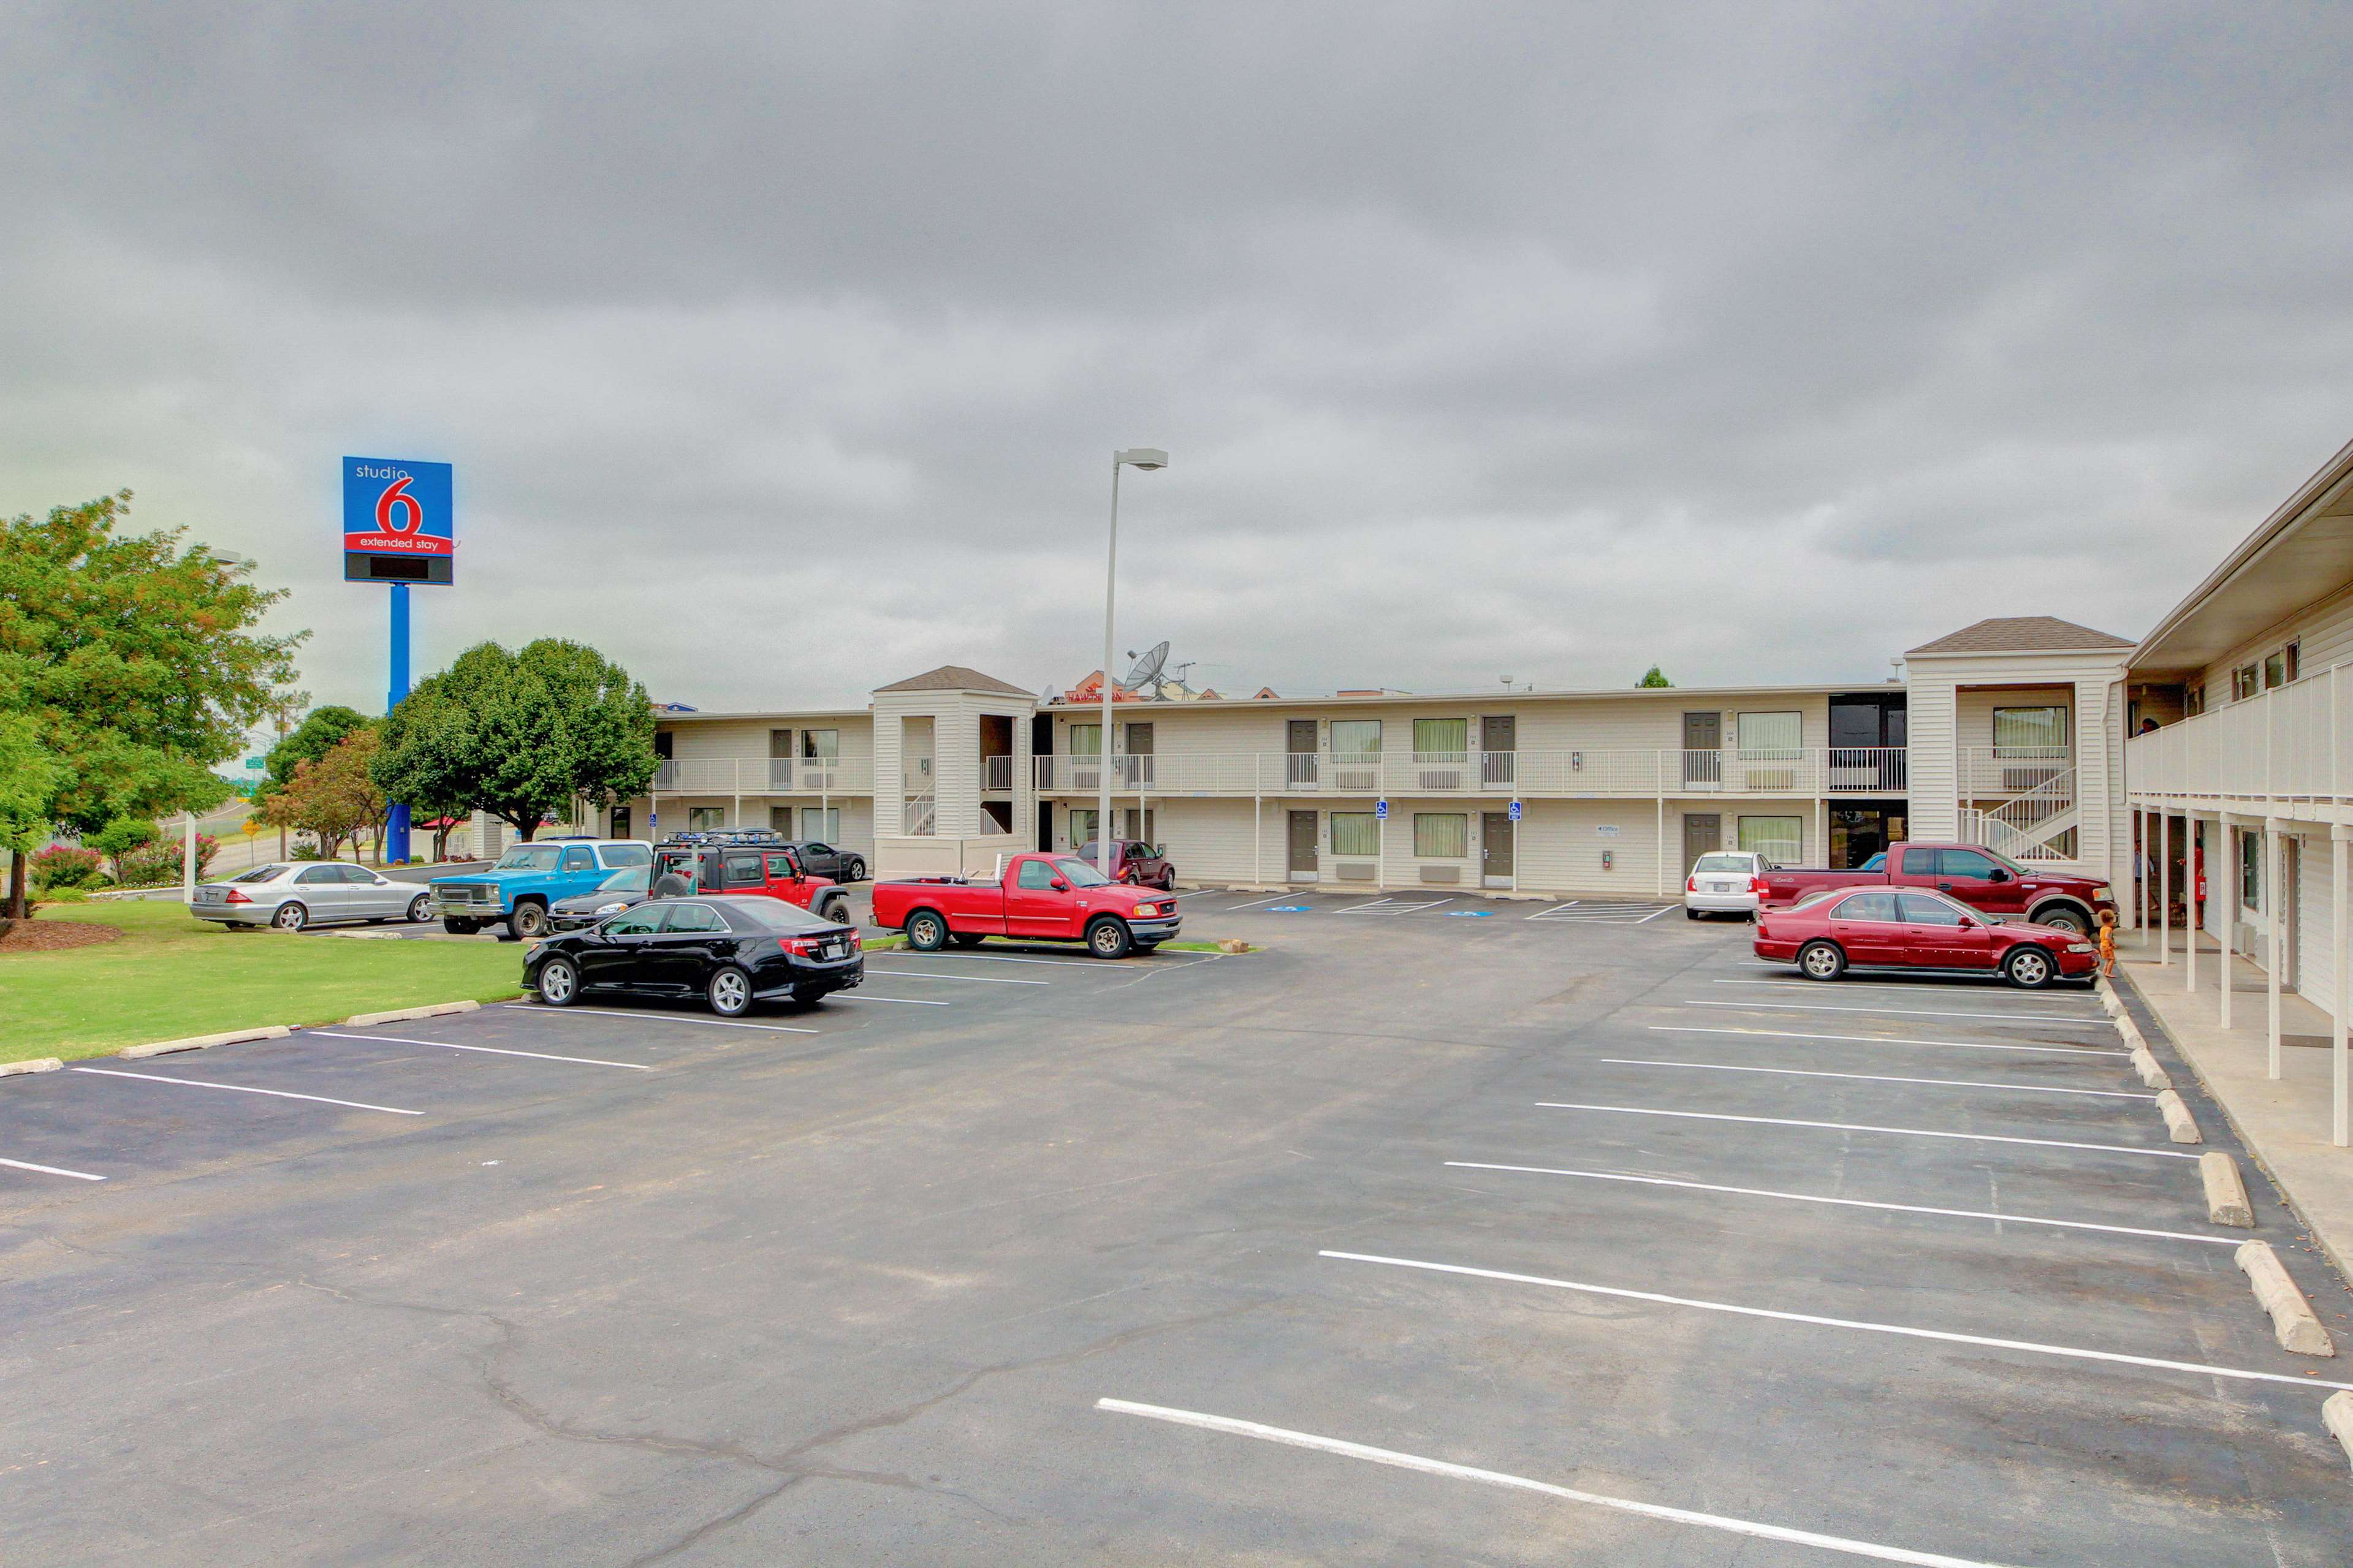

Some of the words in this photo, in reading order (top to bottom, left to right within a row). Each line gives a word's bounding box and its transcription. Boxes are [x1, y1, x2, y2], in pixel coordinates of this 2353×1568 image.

[356, 465, 408, 480] studio
[375, 477, 422, 534] 6
[360, 537, 412, 548] extended
[416, 540, 439, 551] stay
[1068, 691, 1123, 702] HAWTHRN
